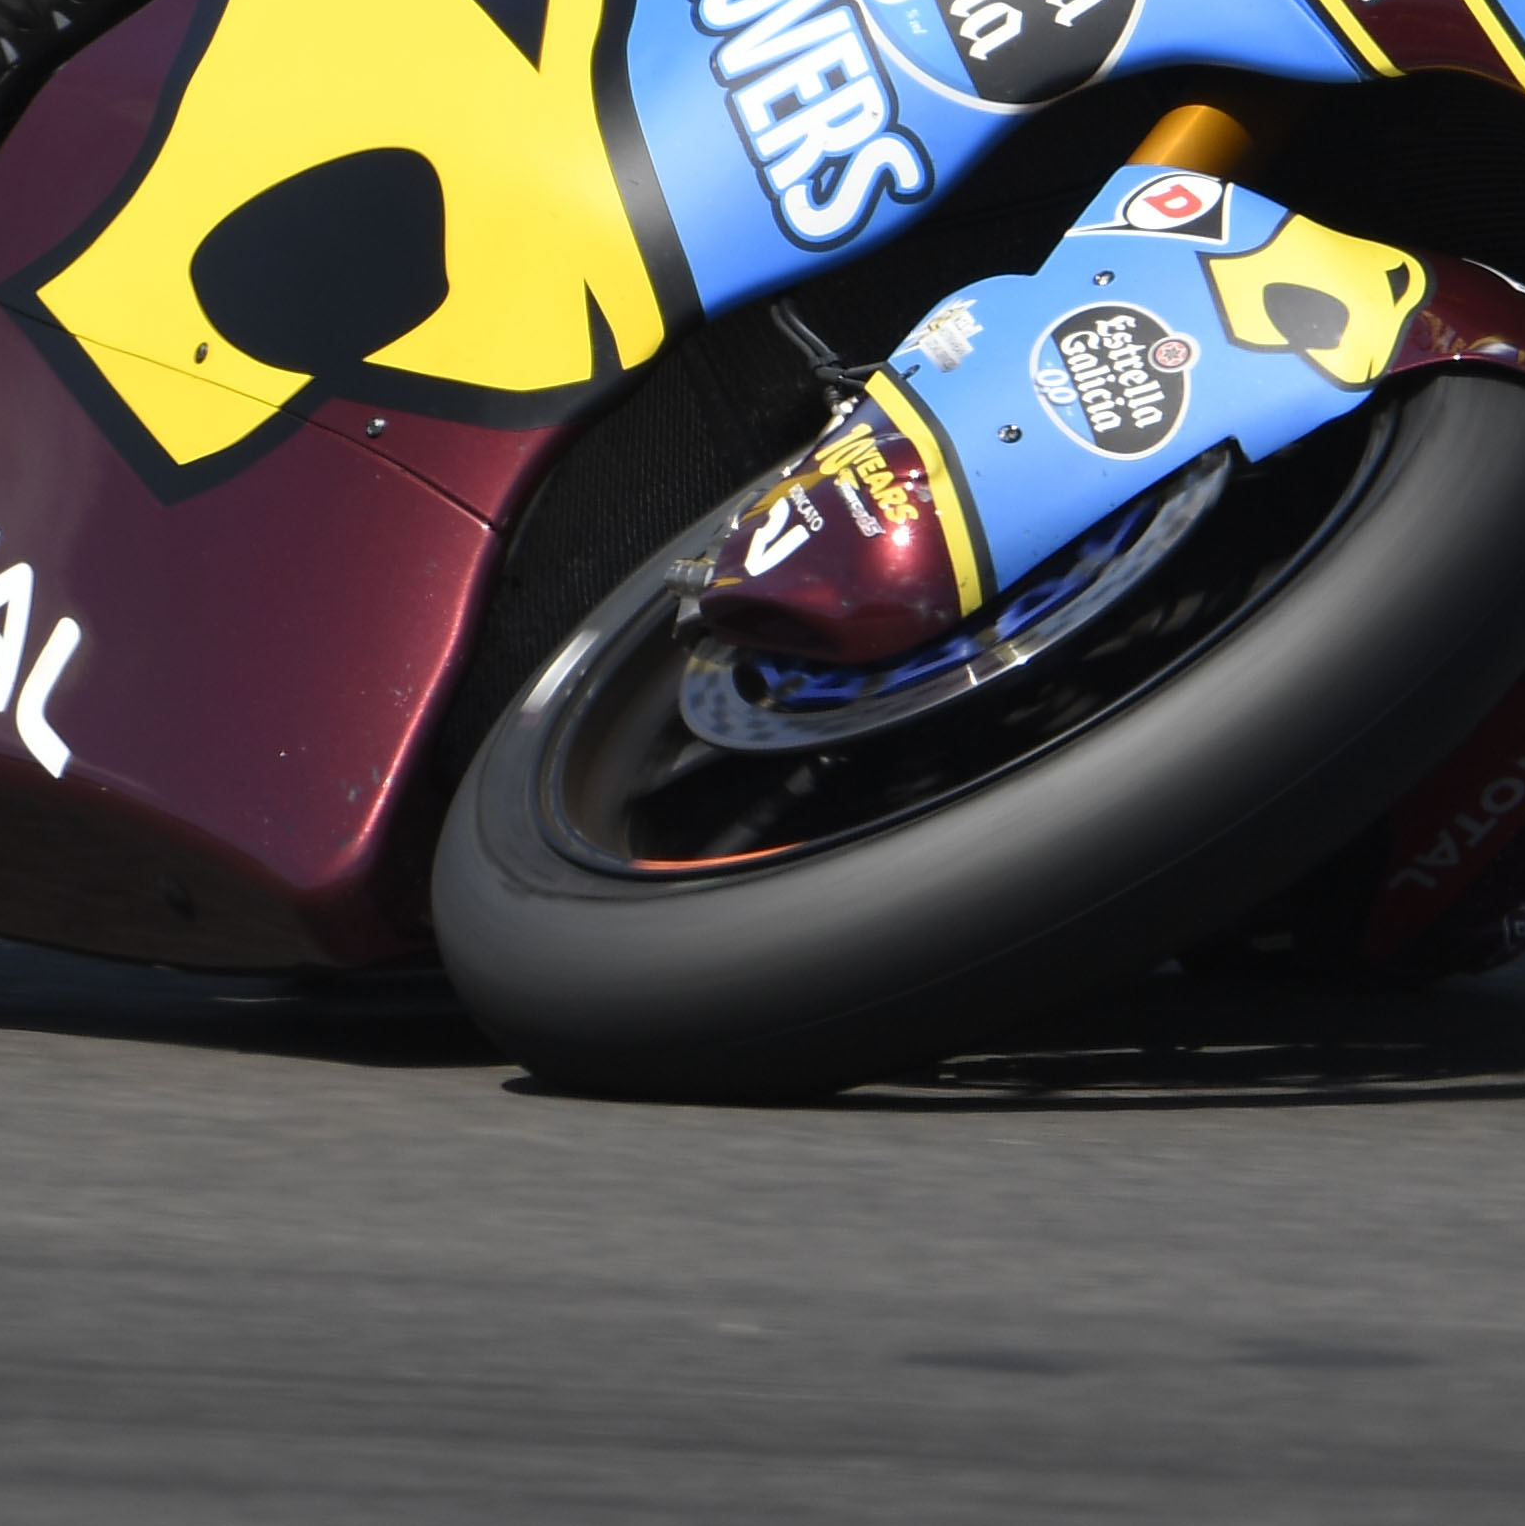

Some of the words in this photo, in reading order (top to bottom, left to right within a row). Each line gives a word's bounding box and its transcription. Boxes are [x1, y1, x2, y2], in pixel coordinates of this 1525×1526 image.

[1060, 330, 1122, 434] Galicia
[1095, 314, 1166, 429] Estrella
[815, 422, 877, 475] 10
[853, 445, 920, 524] YEARS
